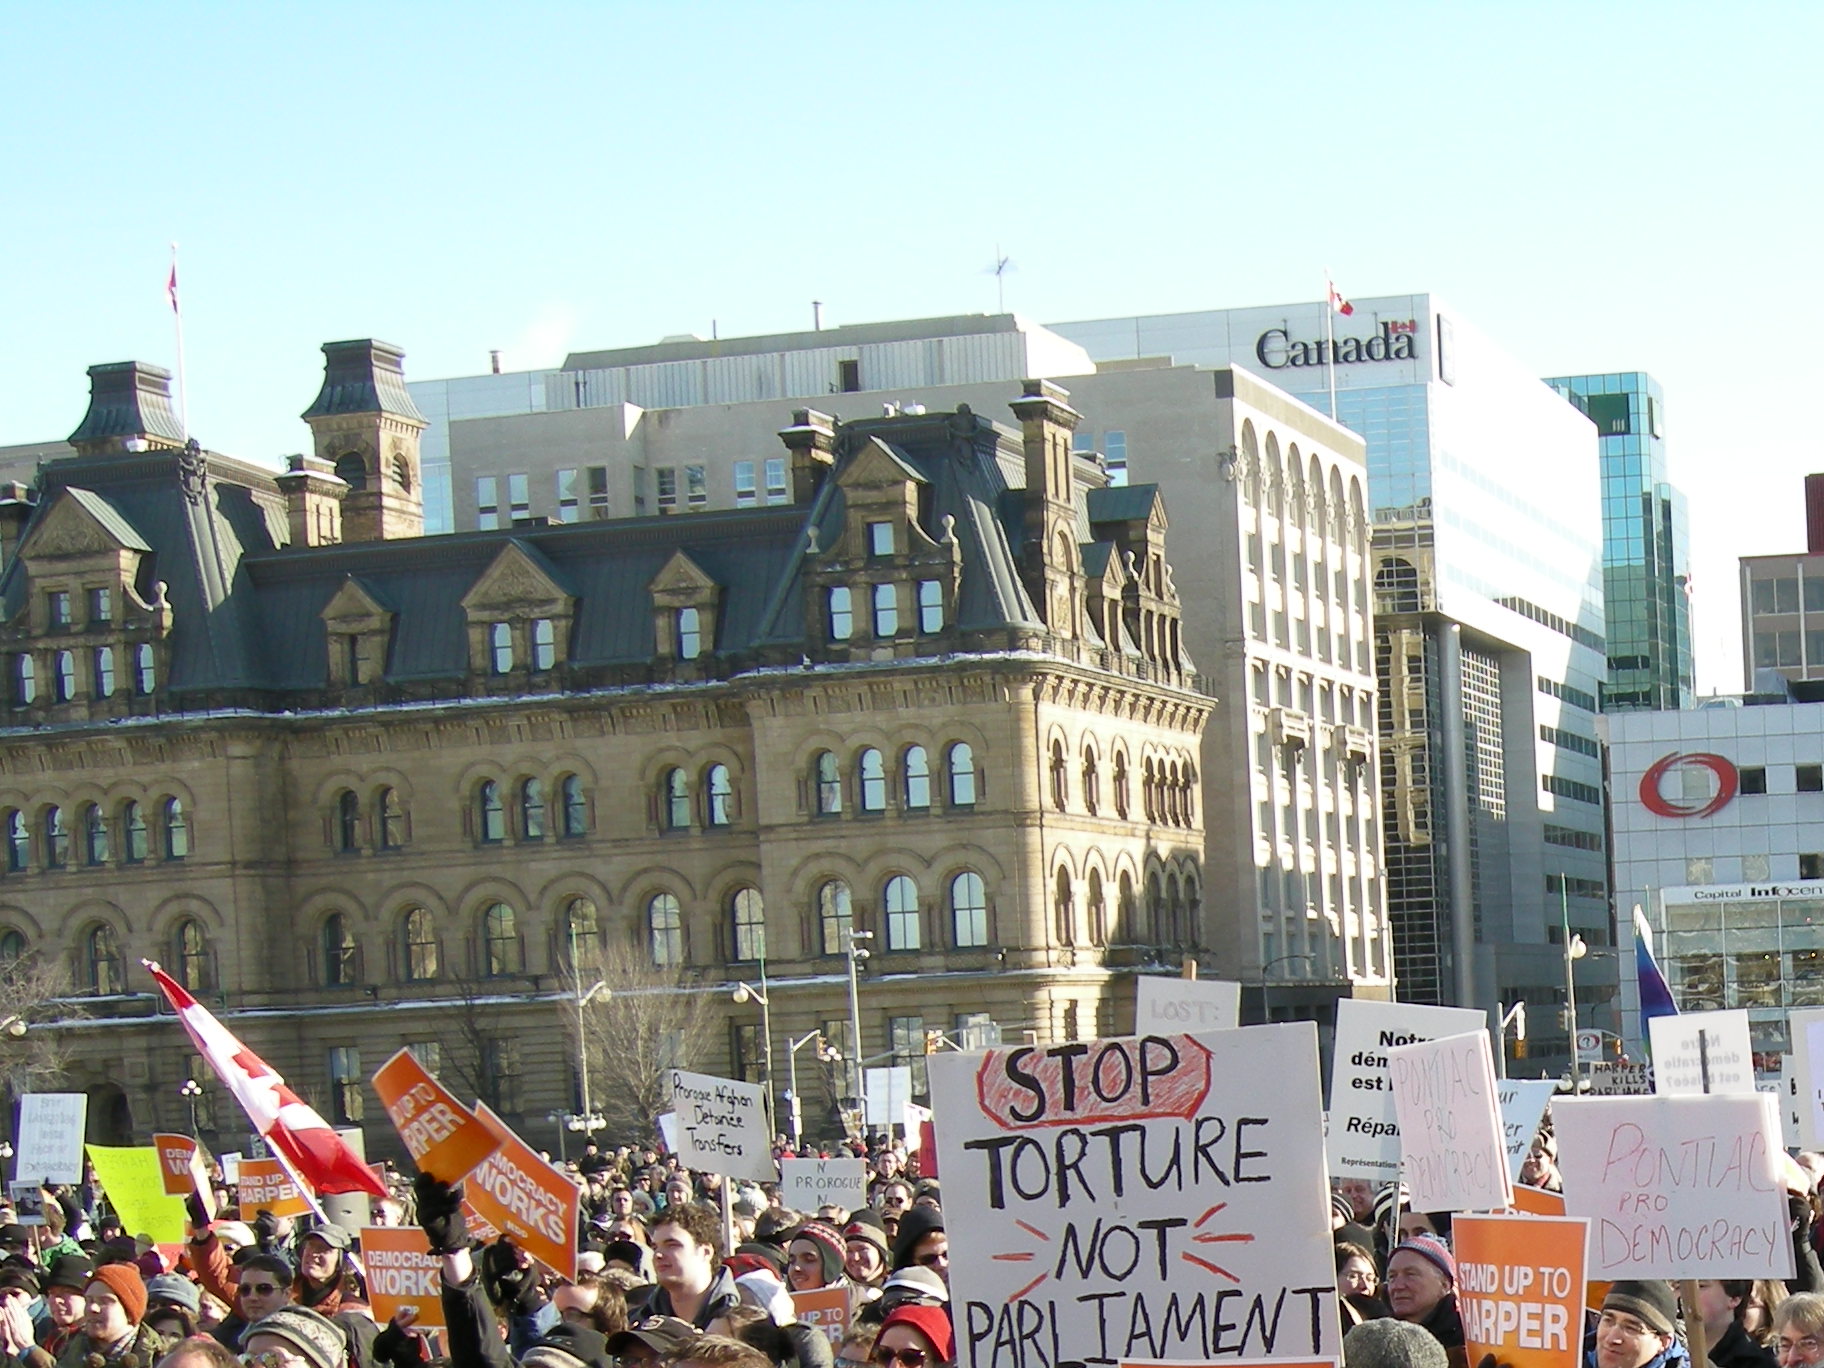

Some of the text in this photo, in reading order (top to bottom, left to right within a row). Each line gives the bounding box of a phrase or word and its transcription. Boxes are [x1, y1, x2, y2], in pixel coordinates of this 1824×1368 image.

[1256, 321, 1418, 369] Canada
[1694, 889, 1741, 900] Capital
[1150, 998, 1220, 1023] LOST:
[1004, 1035, 1180, 1123] STOP
[1351, 1075, 1384, 1091] est
[1396, 1048, 1480, 1108] PONTIAC
[1594, 1063, 1647, 1075] HARPER
[1611, 1074, 1647, 1086] KILLS
[673, 1072, 753, 1114] Prorogue Afghan
[685, 1126, 743, 1156] Transfers
[1423, 1107, 1457, 1144] PRO
[964, 1116, 1272, 1210] TORTURE
[1340, 1156, 1397, 1169] Représentation
[1406, 1143, 1494, 1205] DEMOCRACY
[1602, 1122, 1776, 1192] PONTIAC
[266, 1173, 284, 1186] UP
[795, 1175, 861, 1190] PROROGUE
[475, 1160, 567, 1246] WORKS
[1618, 1191, 1669, 1213] PRO
[368, 1250, 444, 1269] DEMOCRAC
[1054, 1216, 1188, 1283] NOT
[1600, 1217, 1777, 1268] DEMOCRACY
[1458, 1261, 1572, 1299] STAND UP TO
[824, 1307, 844, 1322] TO
[1462, 1298, 1569, 1351] HARPER
